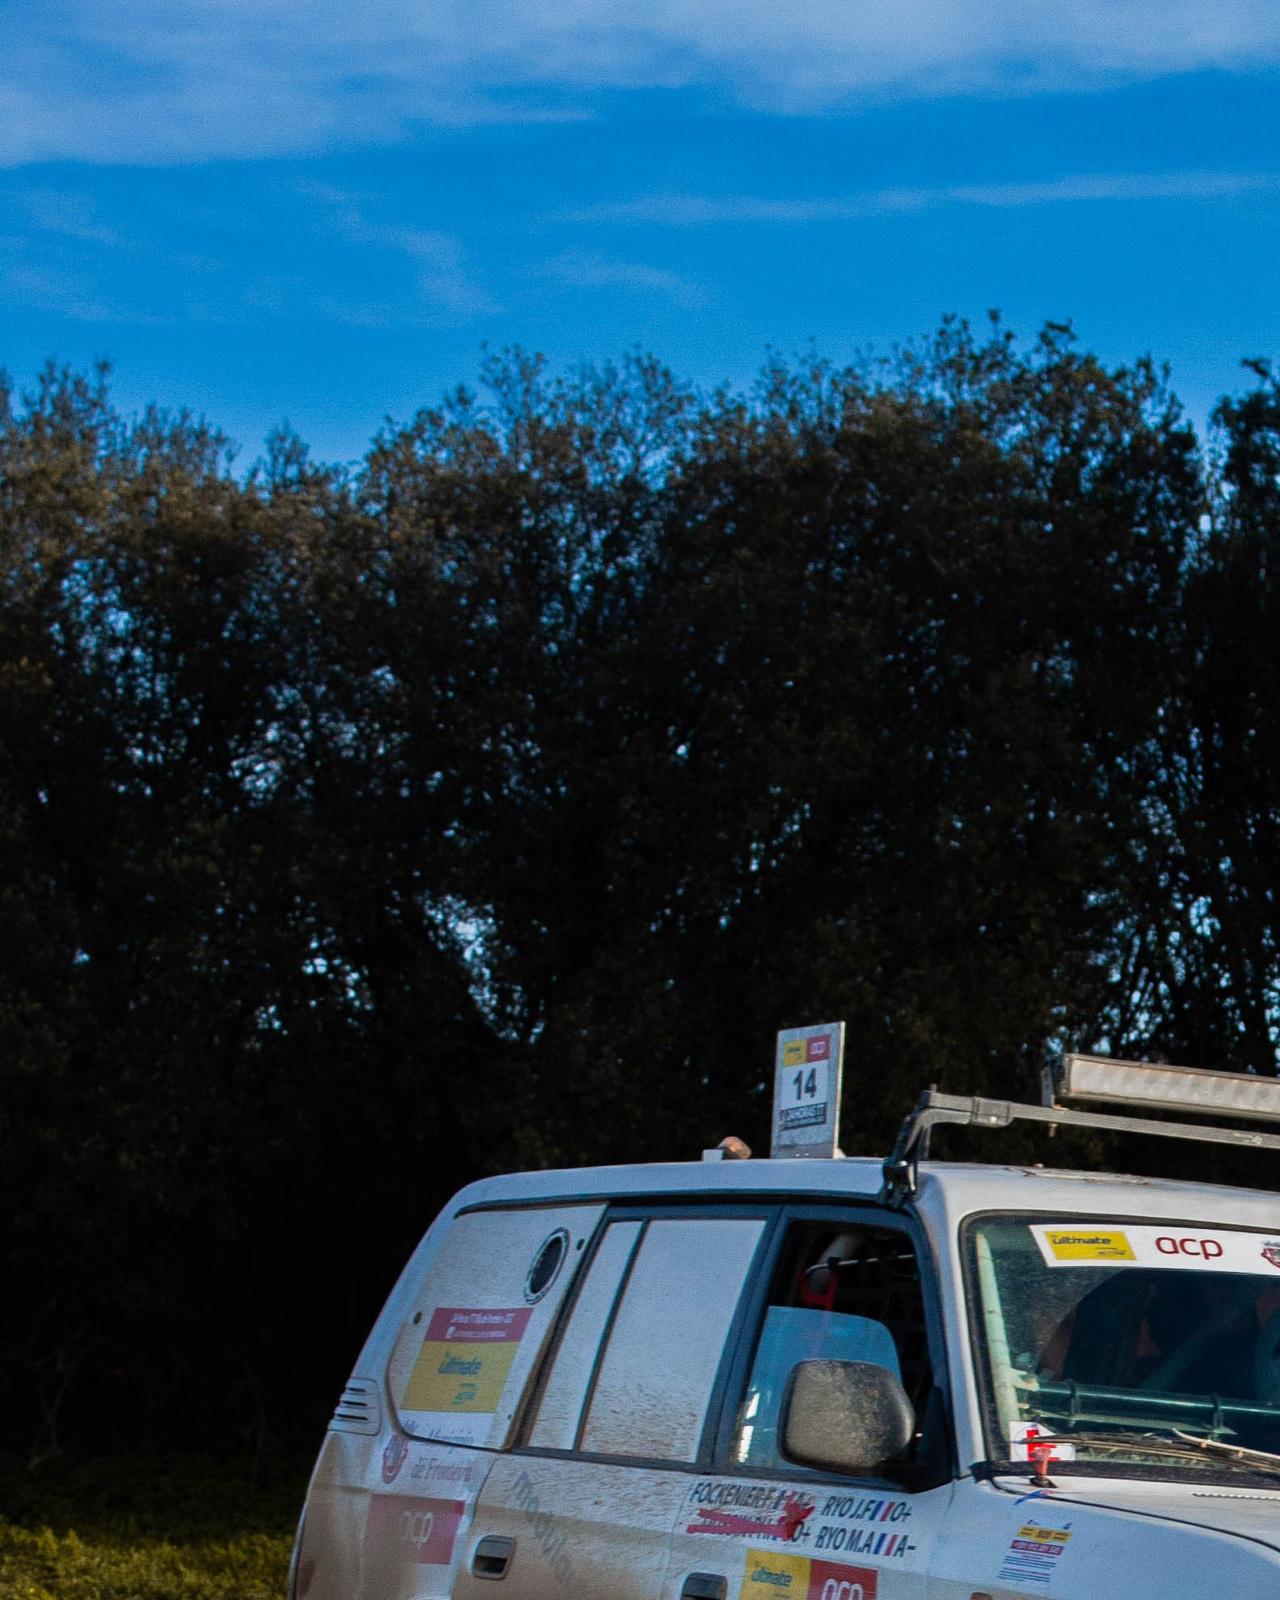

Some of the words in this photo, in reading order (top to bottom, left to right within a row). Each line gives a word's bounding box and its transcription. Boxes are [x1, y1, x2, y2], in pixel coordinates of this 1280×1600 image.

[793, 1067, 817, 1101] 14
[1051, 1236, 1112, 1245] ultimate
[1155, 1236, 1223, 1260] acp
